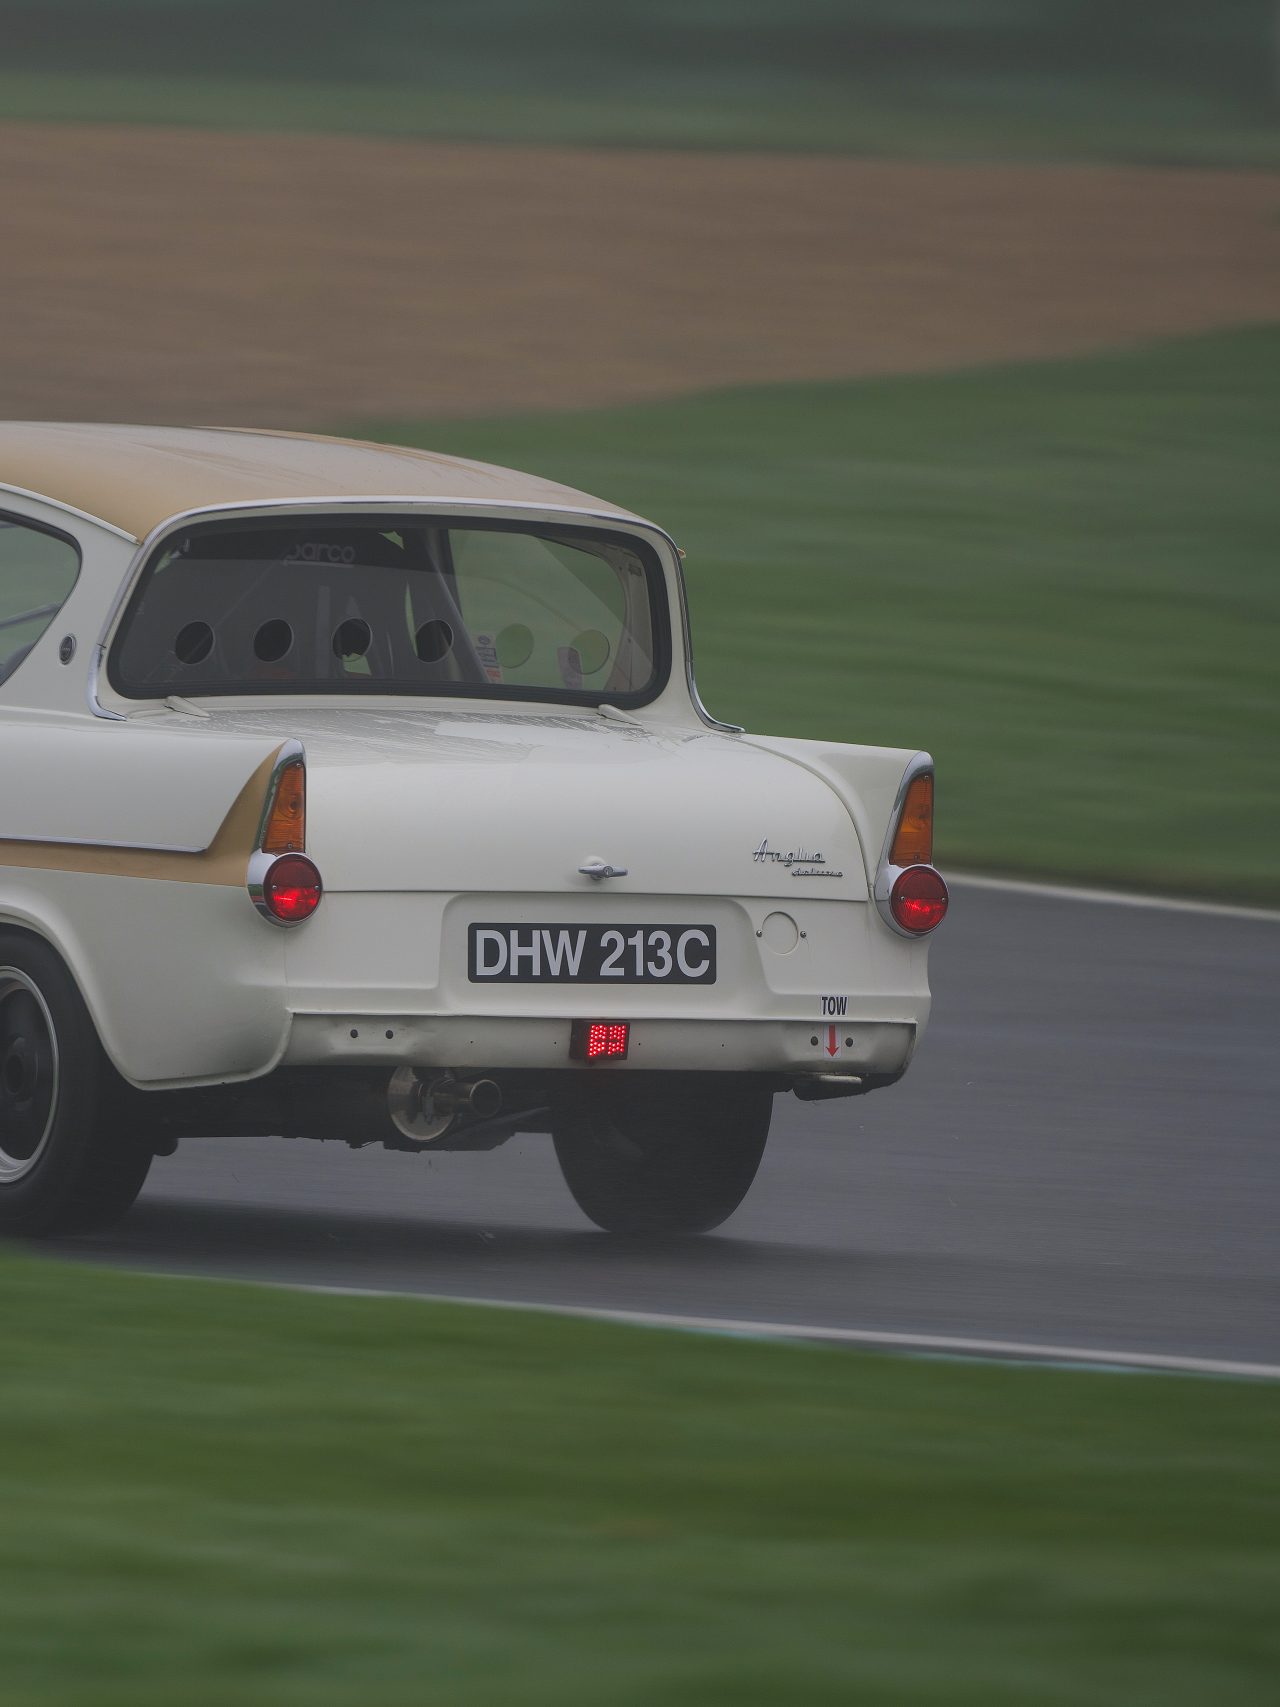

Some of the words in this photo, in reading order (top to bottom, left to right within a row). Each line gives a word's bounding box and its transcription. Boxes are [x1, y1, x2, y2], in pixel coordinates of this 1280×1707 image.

[752, 837, 825, 867] Anglia
[475, 929, 587, 976] DHW
[599, 929, 710, 978] 213C
[821, 996, 848, 1015] TOW
